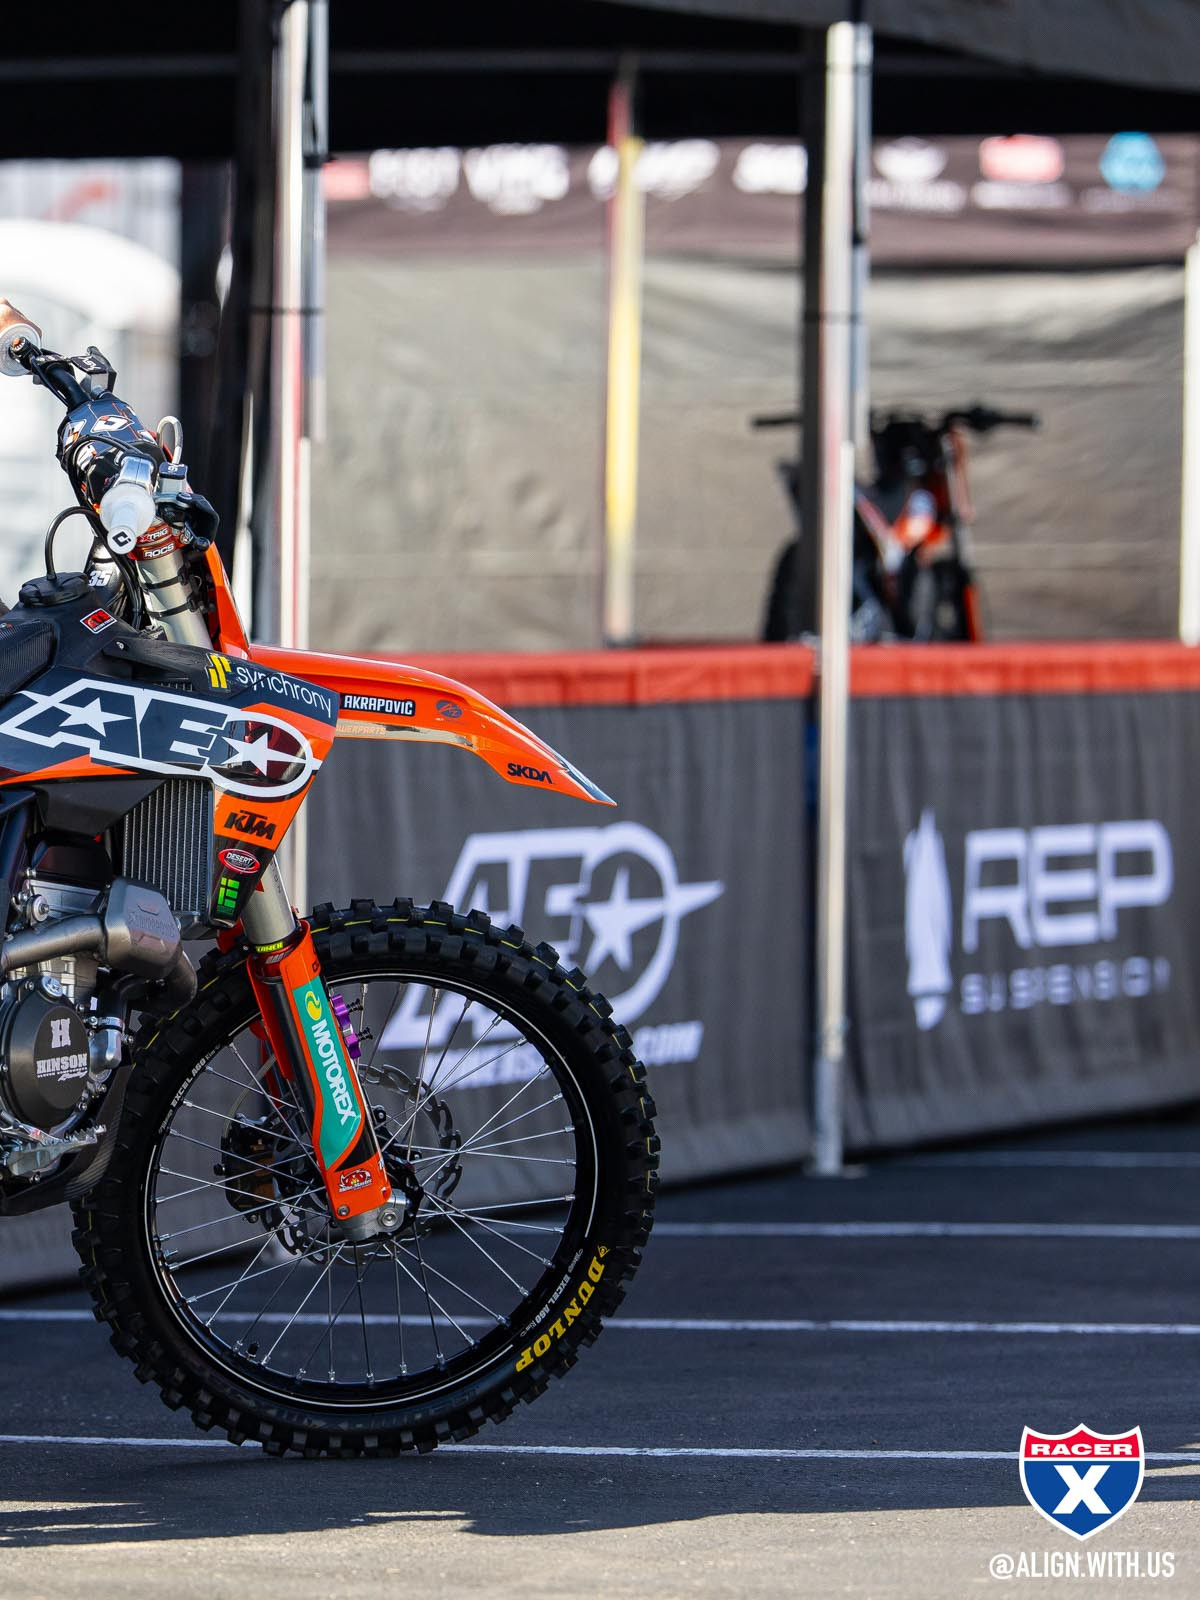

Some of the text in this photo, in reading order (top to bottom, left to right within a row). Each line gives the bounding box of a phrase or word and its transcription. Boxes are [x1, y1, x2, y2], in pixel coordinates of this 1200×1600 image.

[143, 542, 175, 559] ROCS
[88, 570, 112, 587] 35
[236, 666, 331, 719] synchrony
[507, 763, 554, 785] SKDA
[224, 810, 278, 841] KTM
[225, 852, 253, 865] DESERT
[962, 819, 1174, 955] REP
[36, 1053, 88, 1075] HINSON
[311, 1019, 357, 1126] MOTOREX
[170, 1076, 193, 1108] EXCEL
[191, 1057, 206, 1077] A60
[547, 1273, 571, 1305] EXCEL
[515, 1255, 605, 1372] DUNLOP
[535, 1305, 550, 1324] A60
